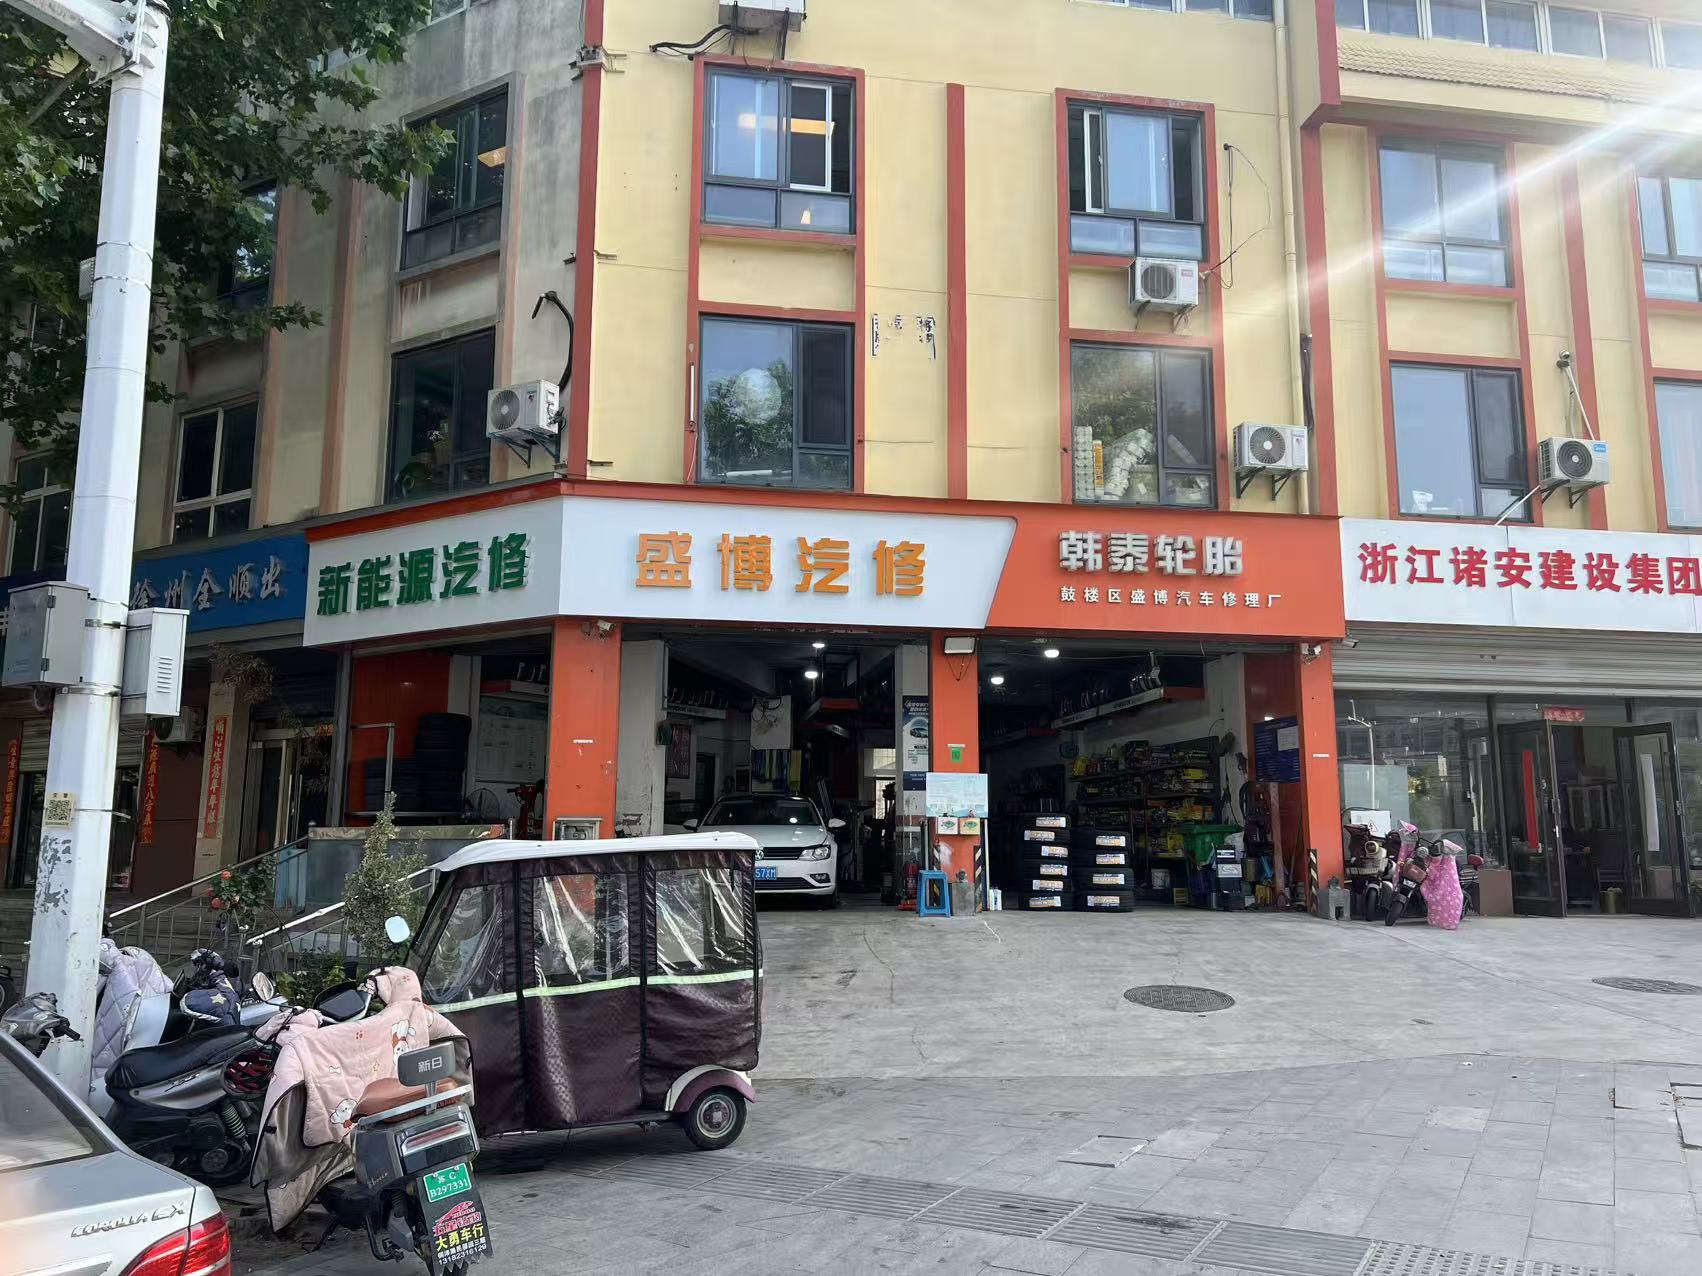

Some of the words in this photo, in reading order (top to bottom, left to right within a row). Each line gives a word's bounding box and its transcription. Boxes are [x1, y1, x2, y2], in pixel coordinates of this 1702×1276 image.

[635, 530, 926, 597] 盛博汽修
[1058, 530, 1244, 577] 韩泰轮胎
[317, 532, 528, 615] 新能源汽修
[1357, 541, 1702, 597] 浙江诸安建设集团
[1060, 585, 1282, 608] 鼓楼区盛博汽车修理厂
[418, 1056, 442, 1073] 新日
[429, 1178, 469, 1198] B297331
[151, 1202, 186, 1222] EX
[435, 1222, 485, 1252] 大勇车行
